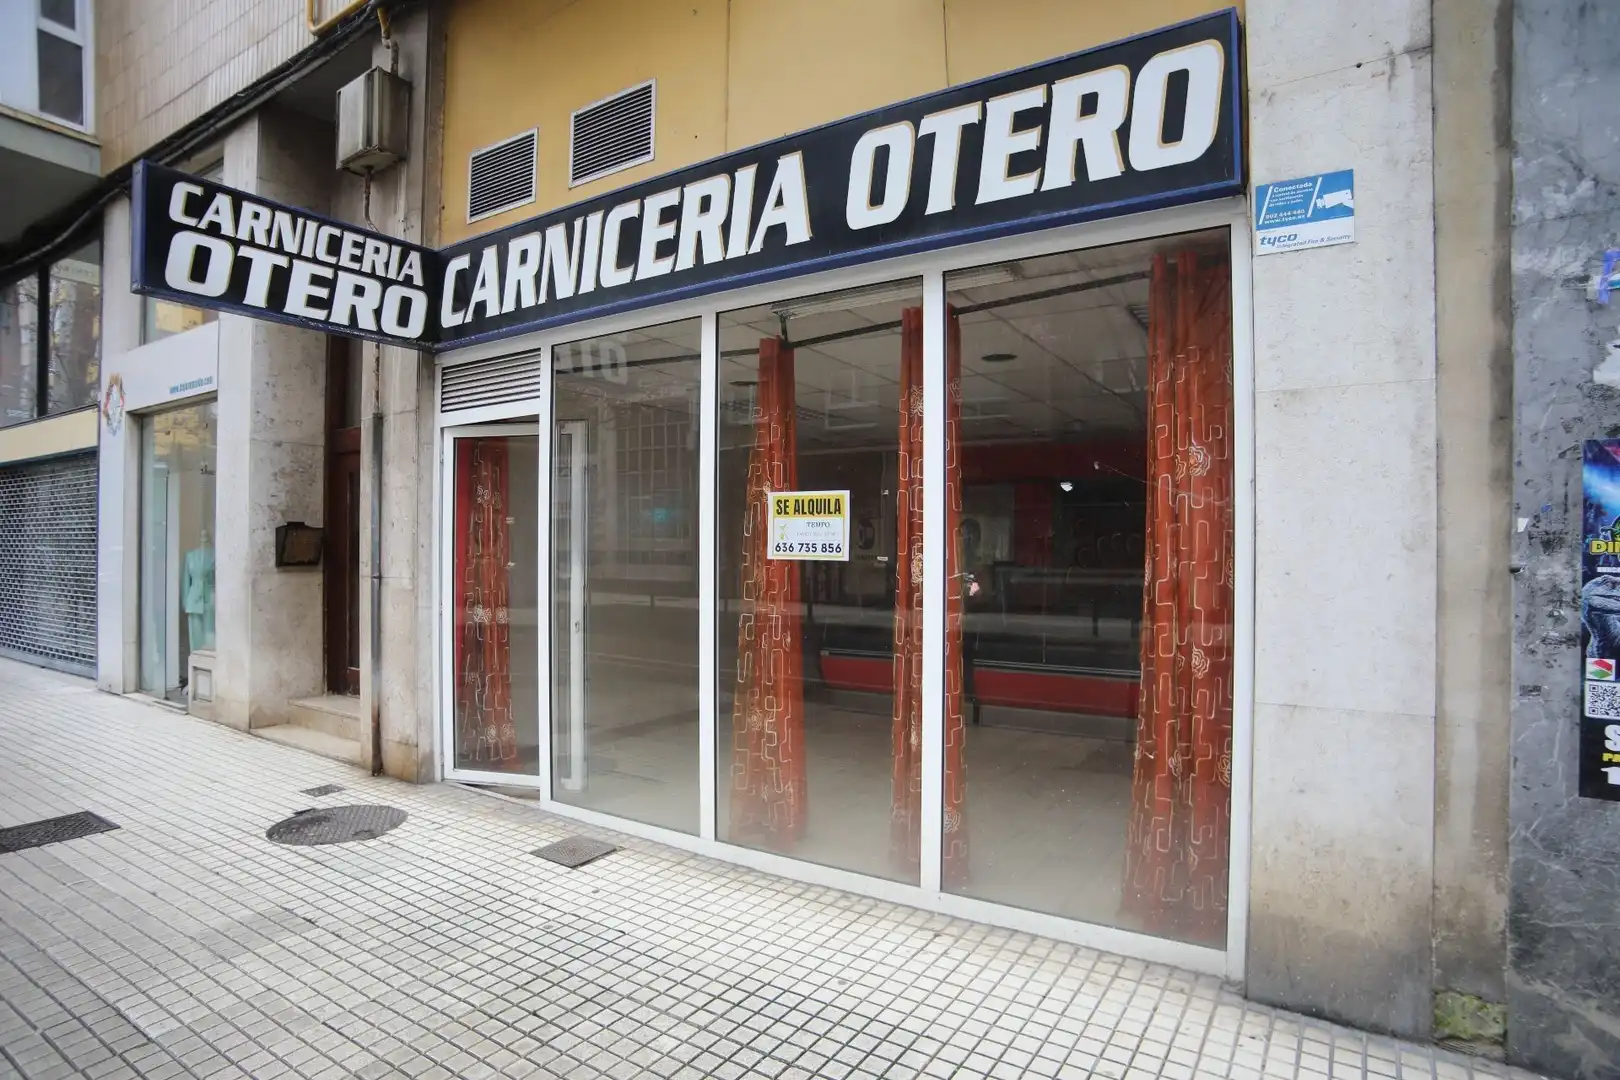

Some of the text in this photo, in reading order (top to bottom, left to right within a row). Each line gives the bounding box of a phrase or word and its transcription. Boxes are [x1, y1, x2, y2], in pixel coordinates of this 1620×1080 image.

[441, 39, 1227, 329] CARNICERIA OTERO
[168, 181, 425, 287] CARNICERIA
[1259, 233, 1298, 247] tyco
[1326, 234, 1351, 242] Security
[165, 231, 428, 339] OTERO
[776, 498, 842, 516] SE ALQUILA
[775, 543, 842, 553] 636 735 856
